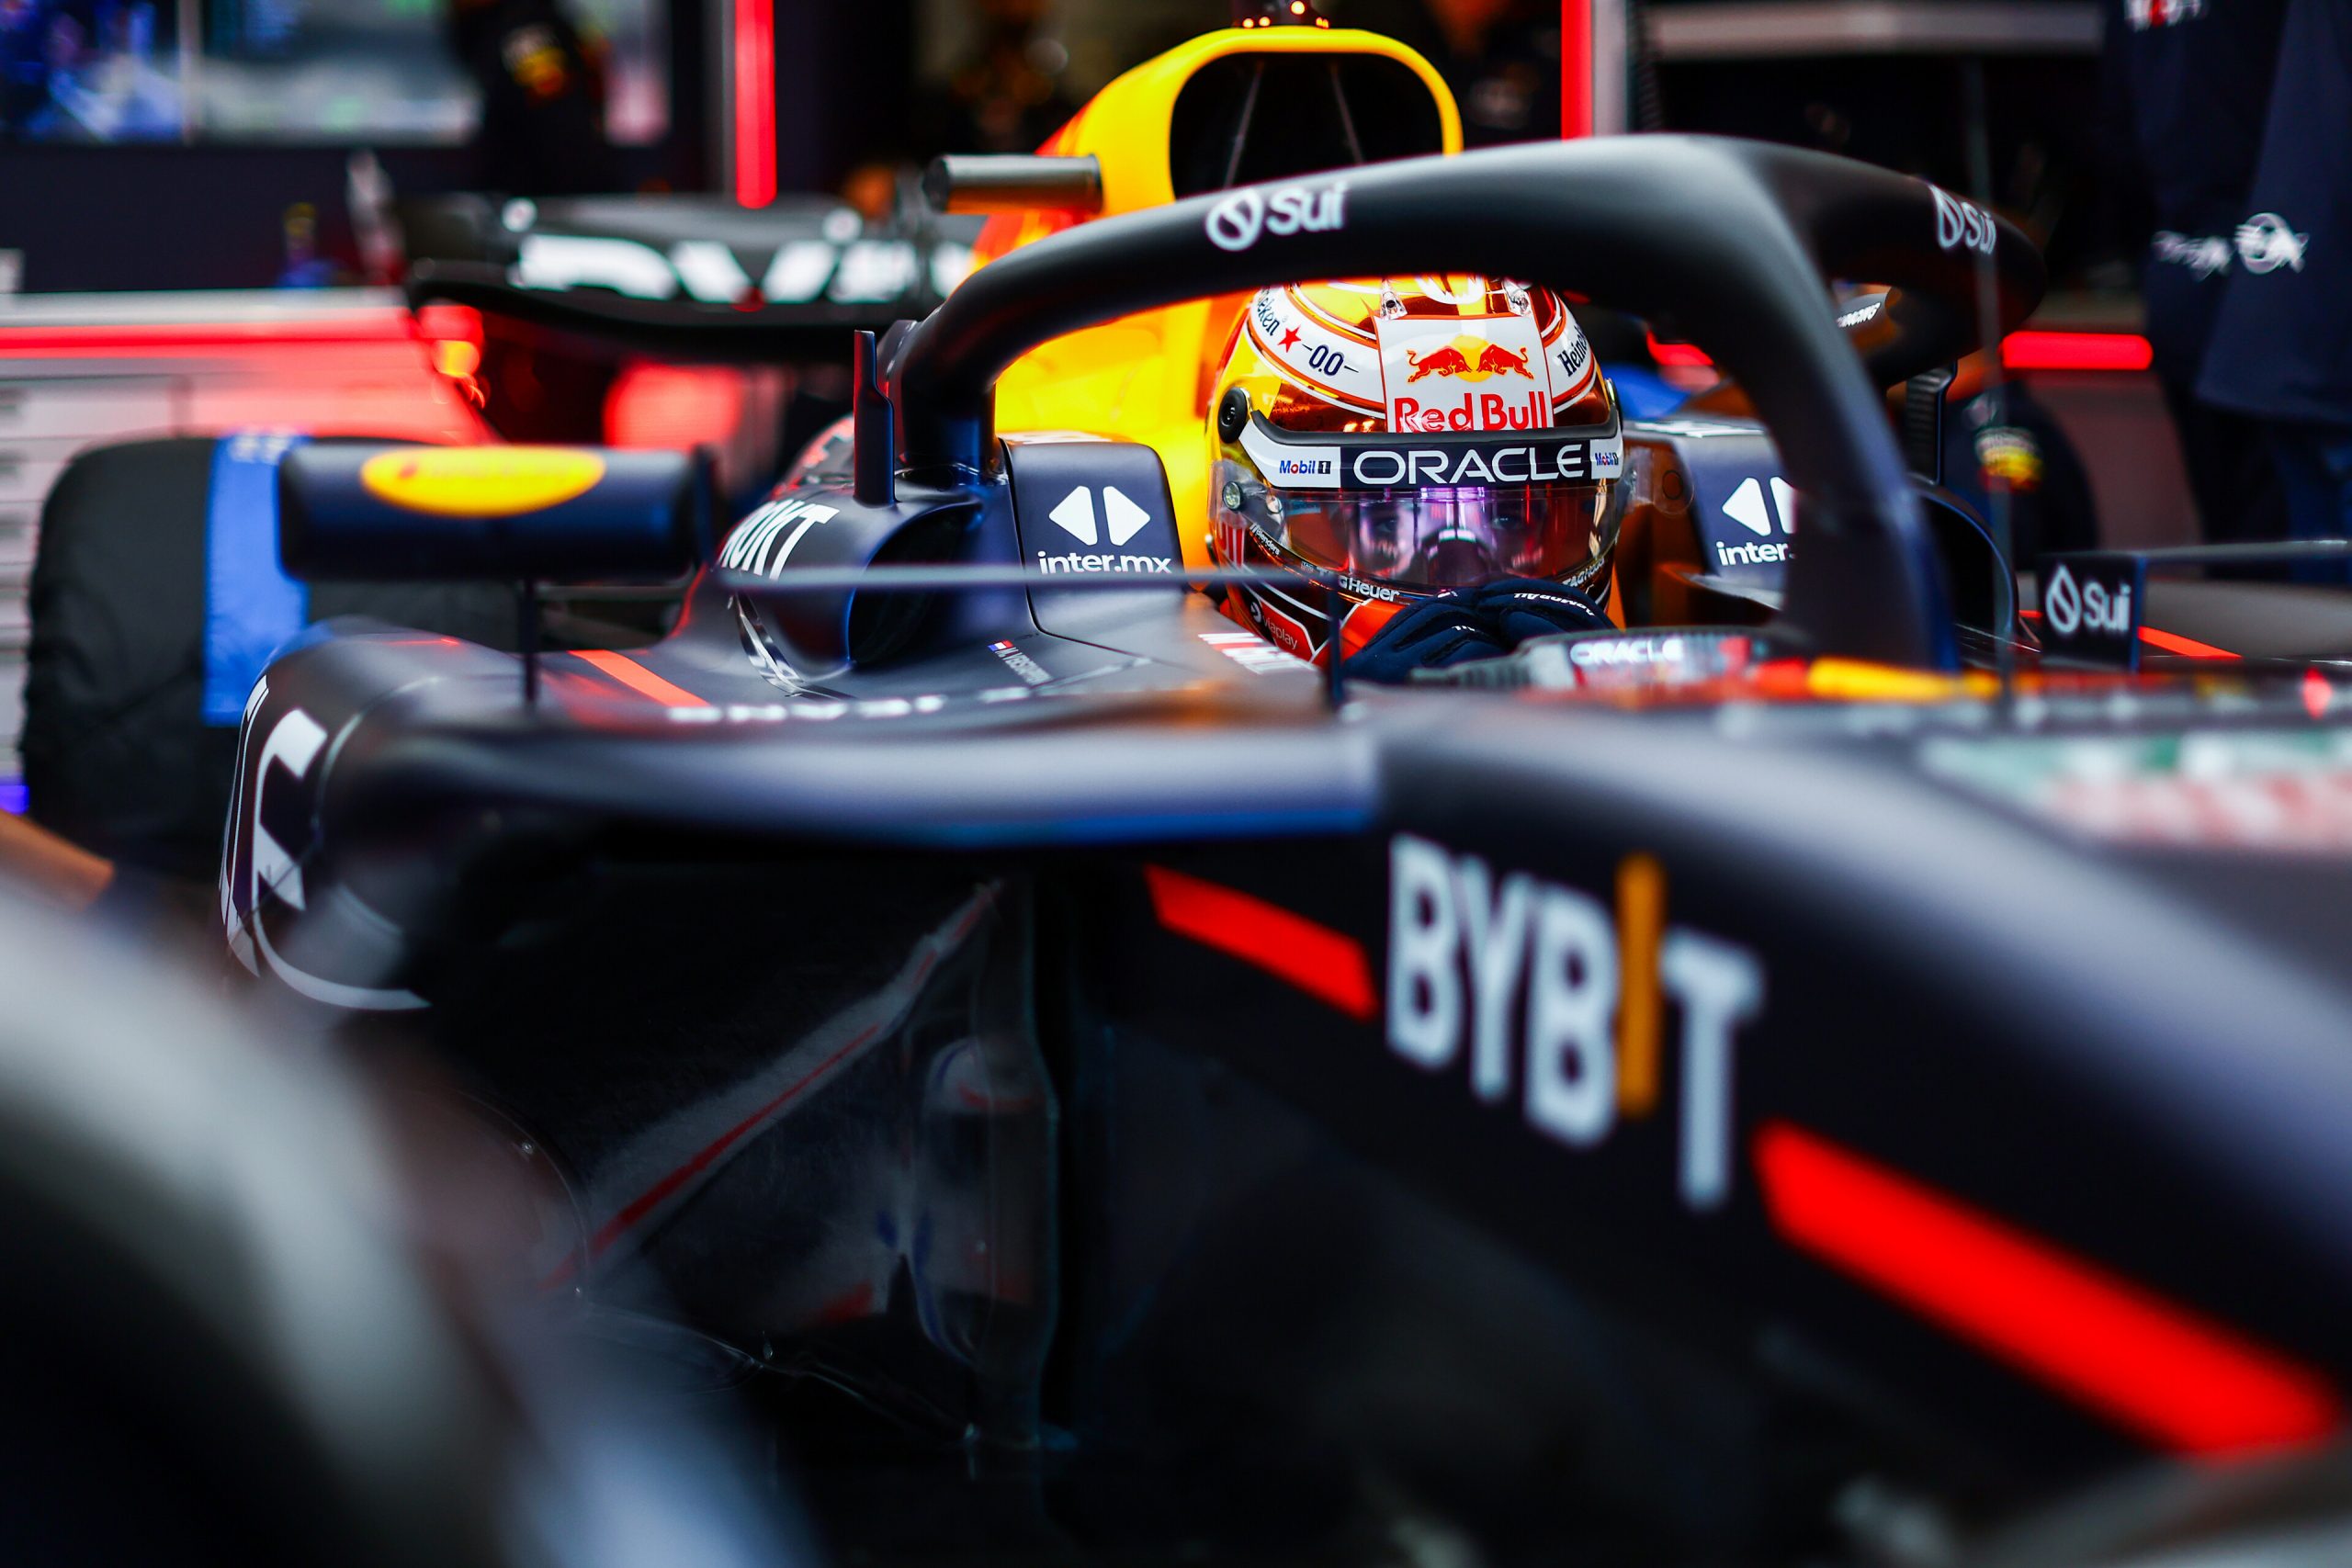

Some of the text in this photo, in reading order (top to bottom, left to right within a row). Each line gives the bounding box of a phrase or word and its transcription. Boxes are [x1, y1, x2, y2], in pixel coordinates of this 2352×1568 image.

[1266, 182, 1348, 235] Sui
[1962, 201, 1996, 254] Sui
[1395, 391, 1548, 433] Red Bull
[1280, 460, 1315, 474] Mobil
[1353, 445, 1584, 485] ORACLE
[1037, 551, 1172, 574] inter.mx
[2083, 581, 2132, 631] Sui
[1263, 616, 1298, 650] viaplay
[1386, 832, 1764, 1208] BYBIT
